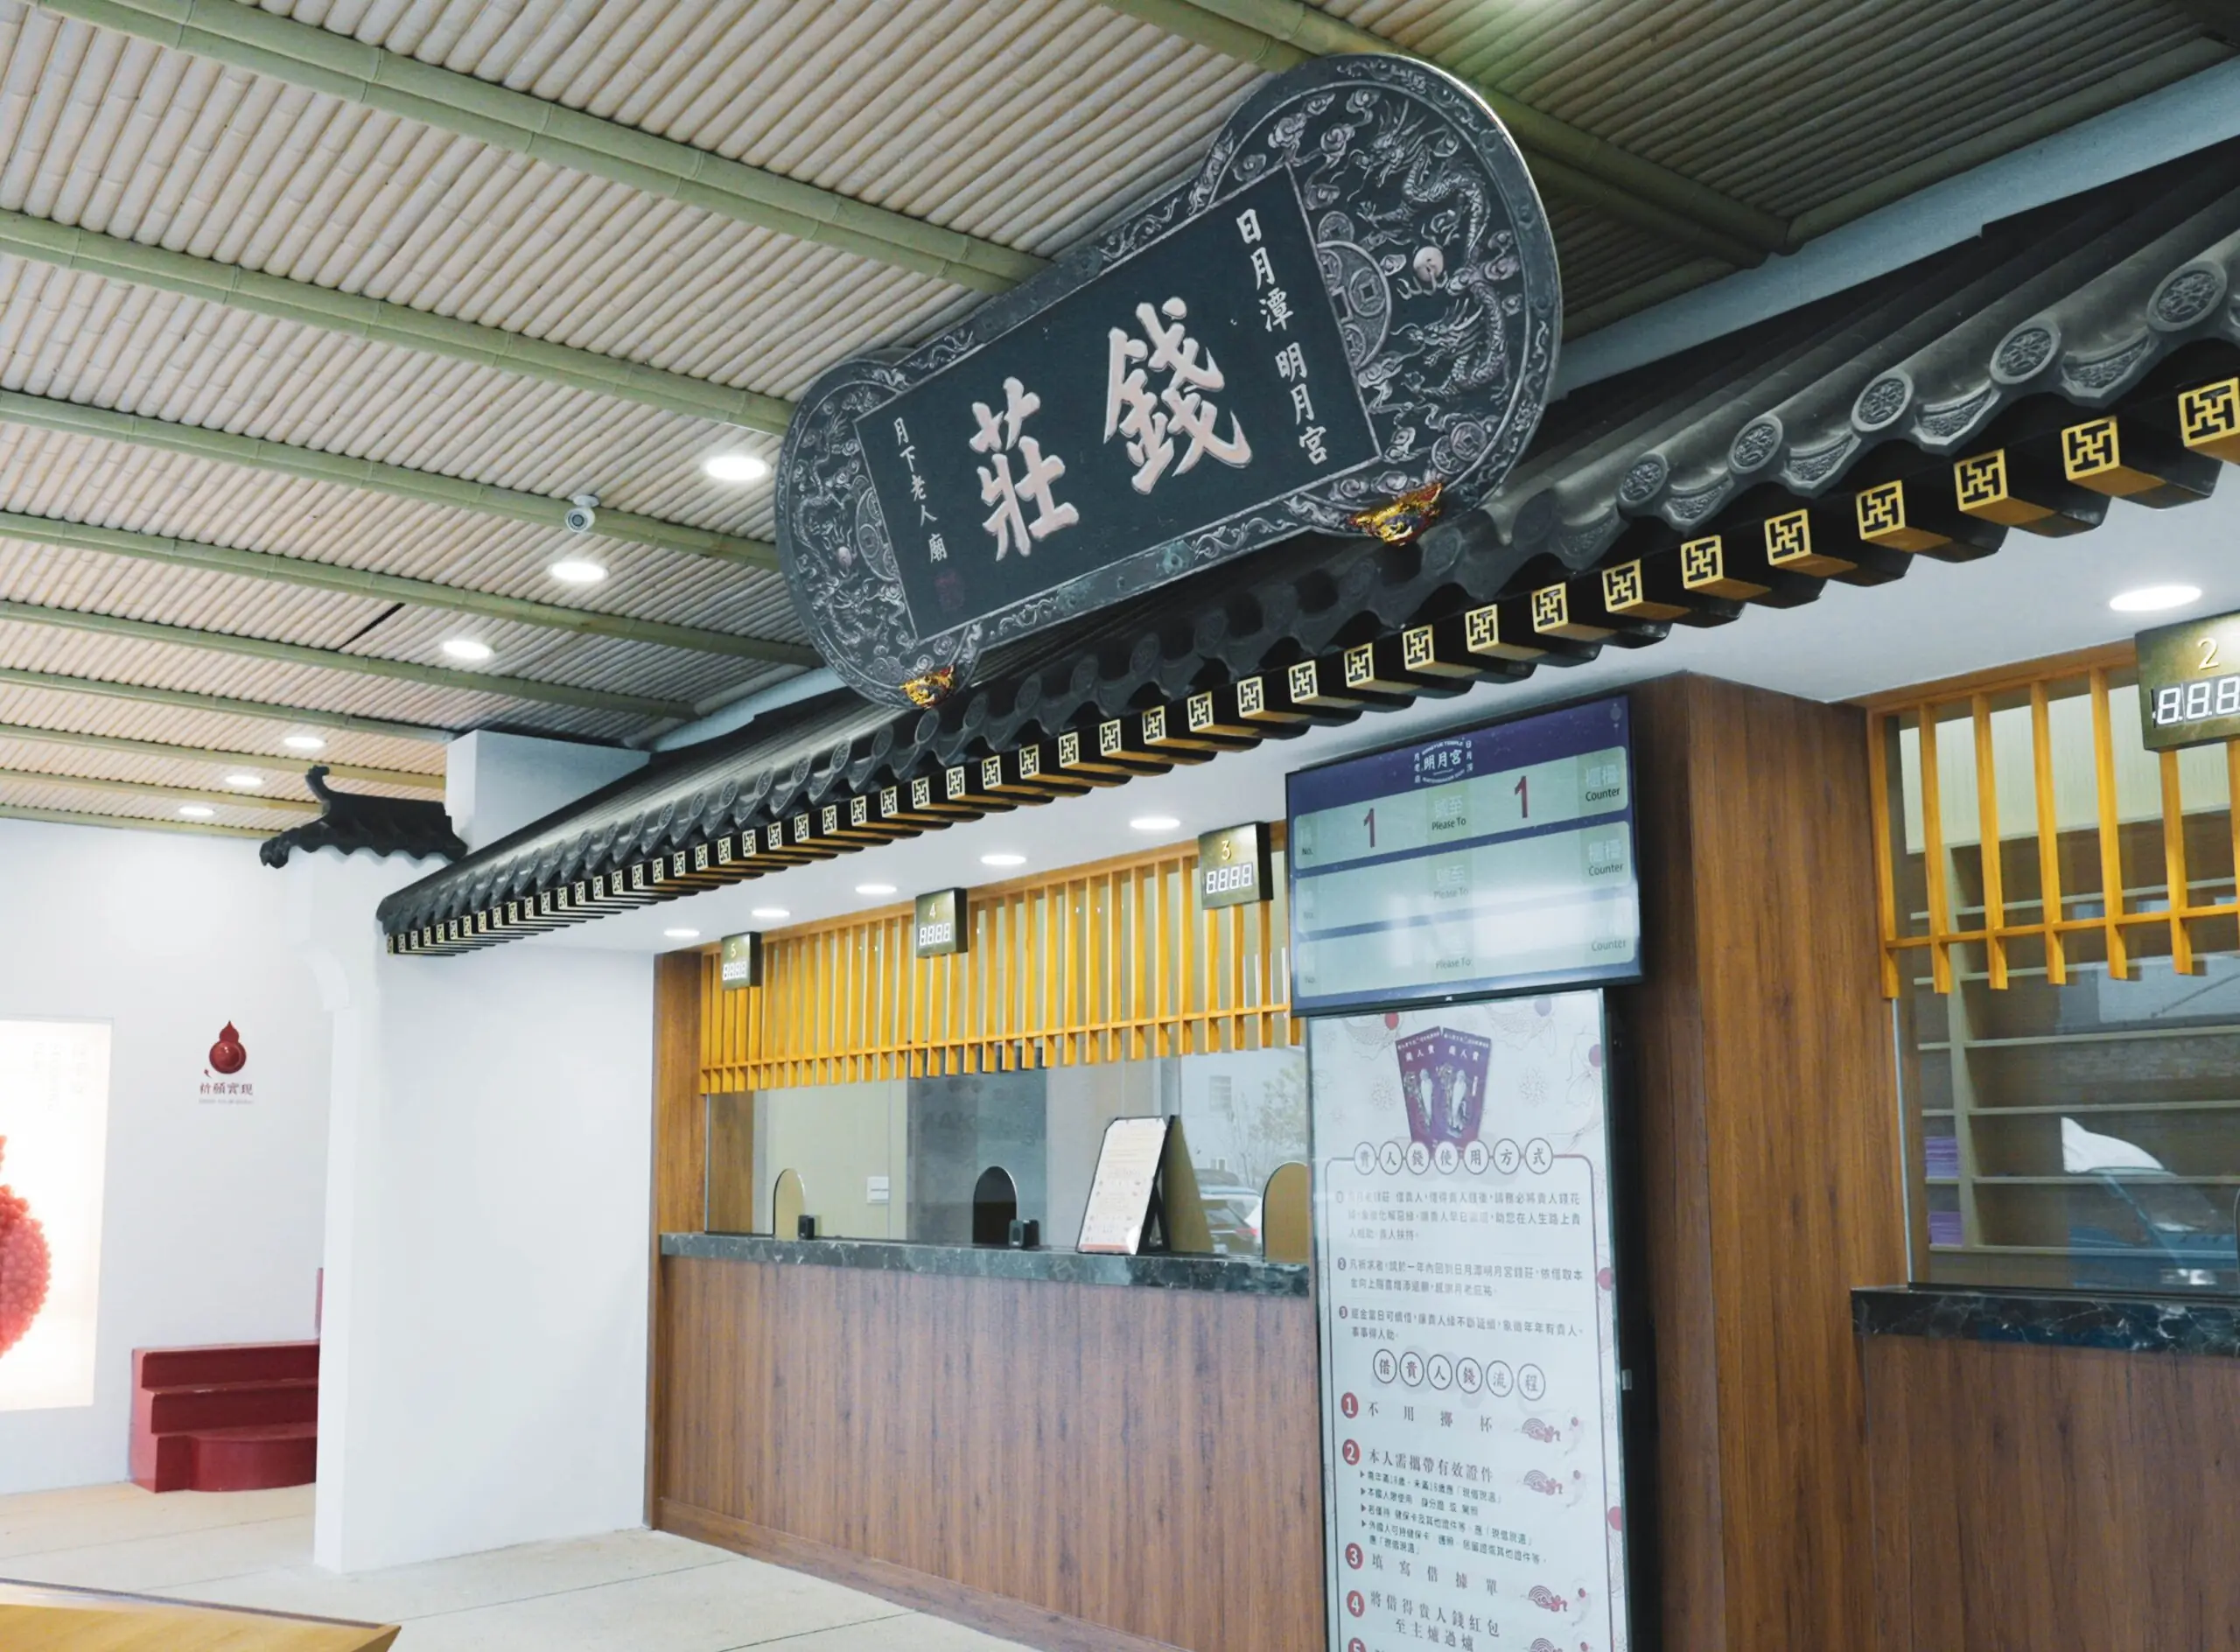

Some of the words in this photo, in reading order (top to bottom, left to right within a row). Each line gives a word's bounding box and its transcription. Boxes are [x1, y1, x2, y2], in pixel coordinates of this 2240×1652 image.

[2197, 636, 2220, 670] 2
[1424, 748, 1462, 771] 明月宮
[1514, 775, 1529, 819] 1
[1586, 787, 1620, 802] Counter
[1363, 808, 1376, 848] 1
[1432, 819, 1455, 831] Please
[1457, 817, 1466, 827] To
[1221, 840, 1232, 860] 3
[1588, 863, 1624, 877] Counter
[1433, 889, 1458, 900] Please
[1460, 887, 1469, 896] To
[929, 902, 936, 919] 4
[730, 942, 737, 959] 5
[1591, 938, 1627, 952] Counter
[1436, 959, 1460, 970] Please
